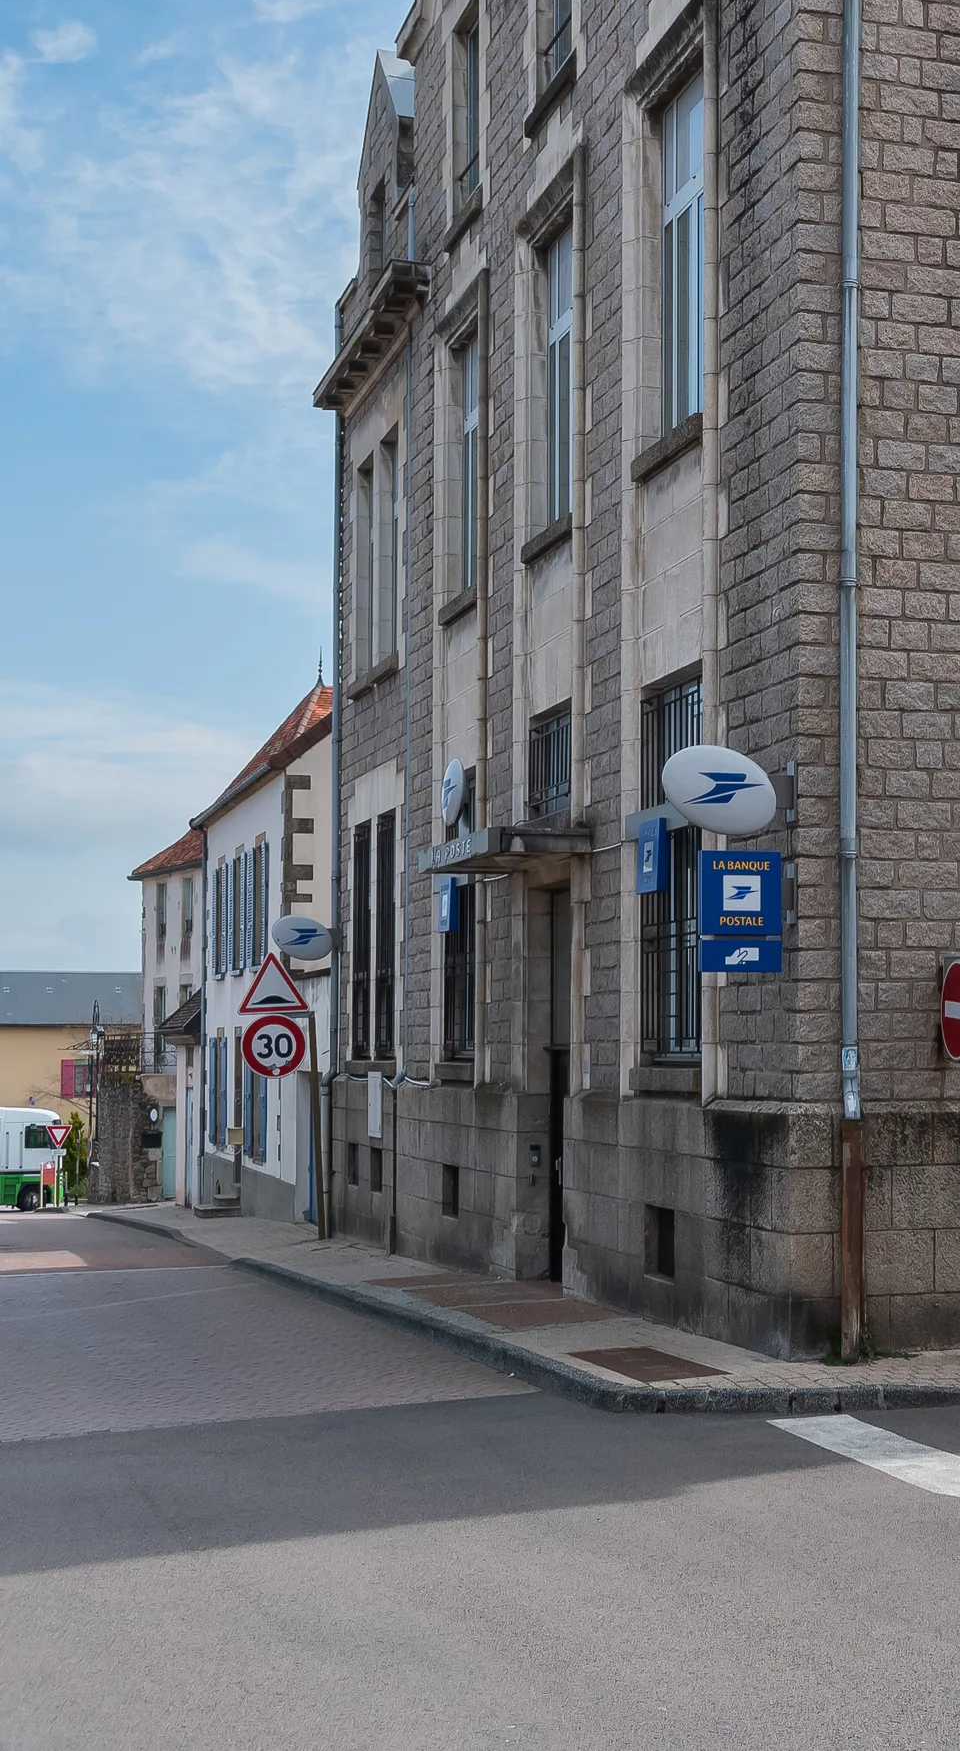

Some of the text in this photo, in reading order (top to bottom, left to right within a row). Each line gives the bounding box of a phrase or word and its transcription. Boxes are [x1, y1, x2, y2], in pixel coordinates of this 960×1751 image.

[431, 838, 472, 868] LA POSTE
[713, 860, 770, 872] LA BANQUE
[720, 916, 764, 926] POSTALE
[256, 1033, 293, 1059] 30
